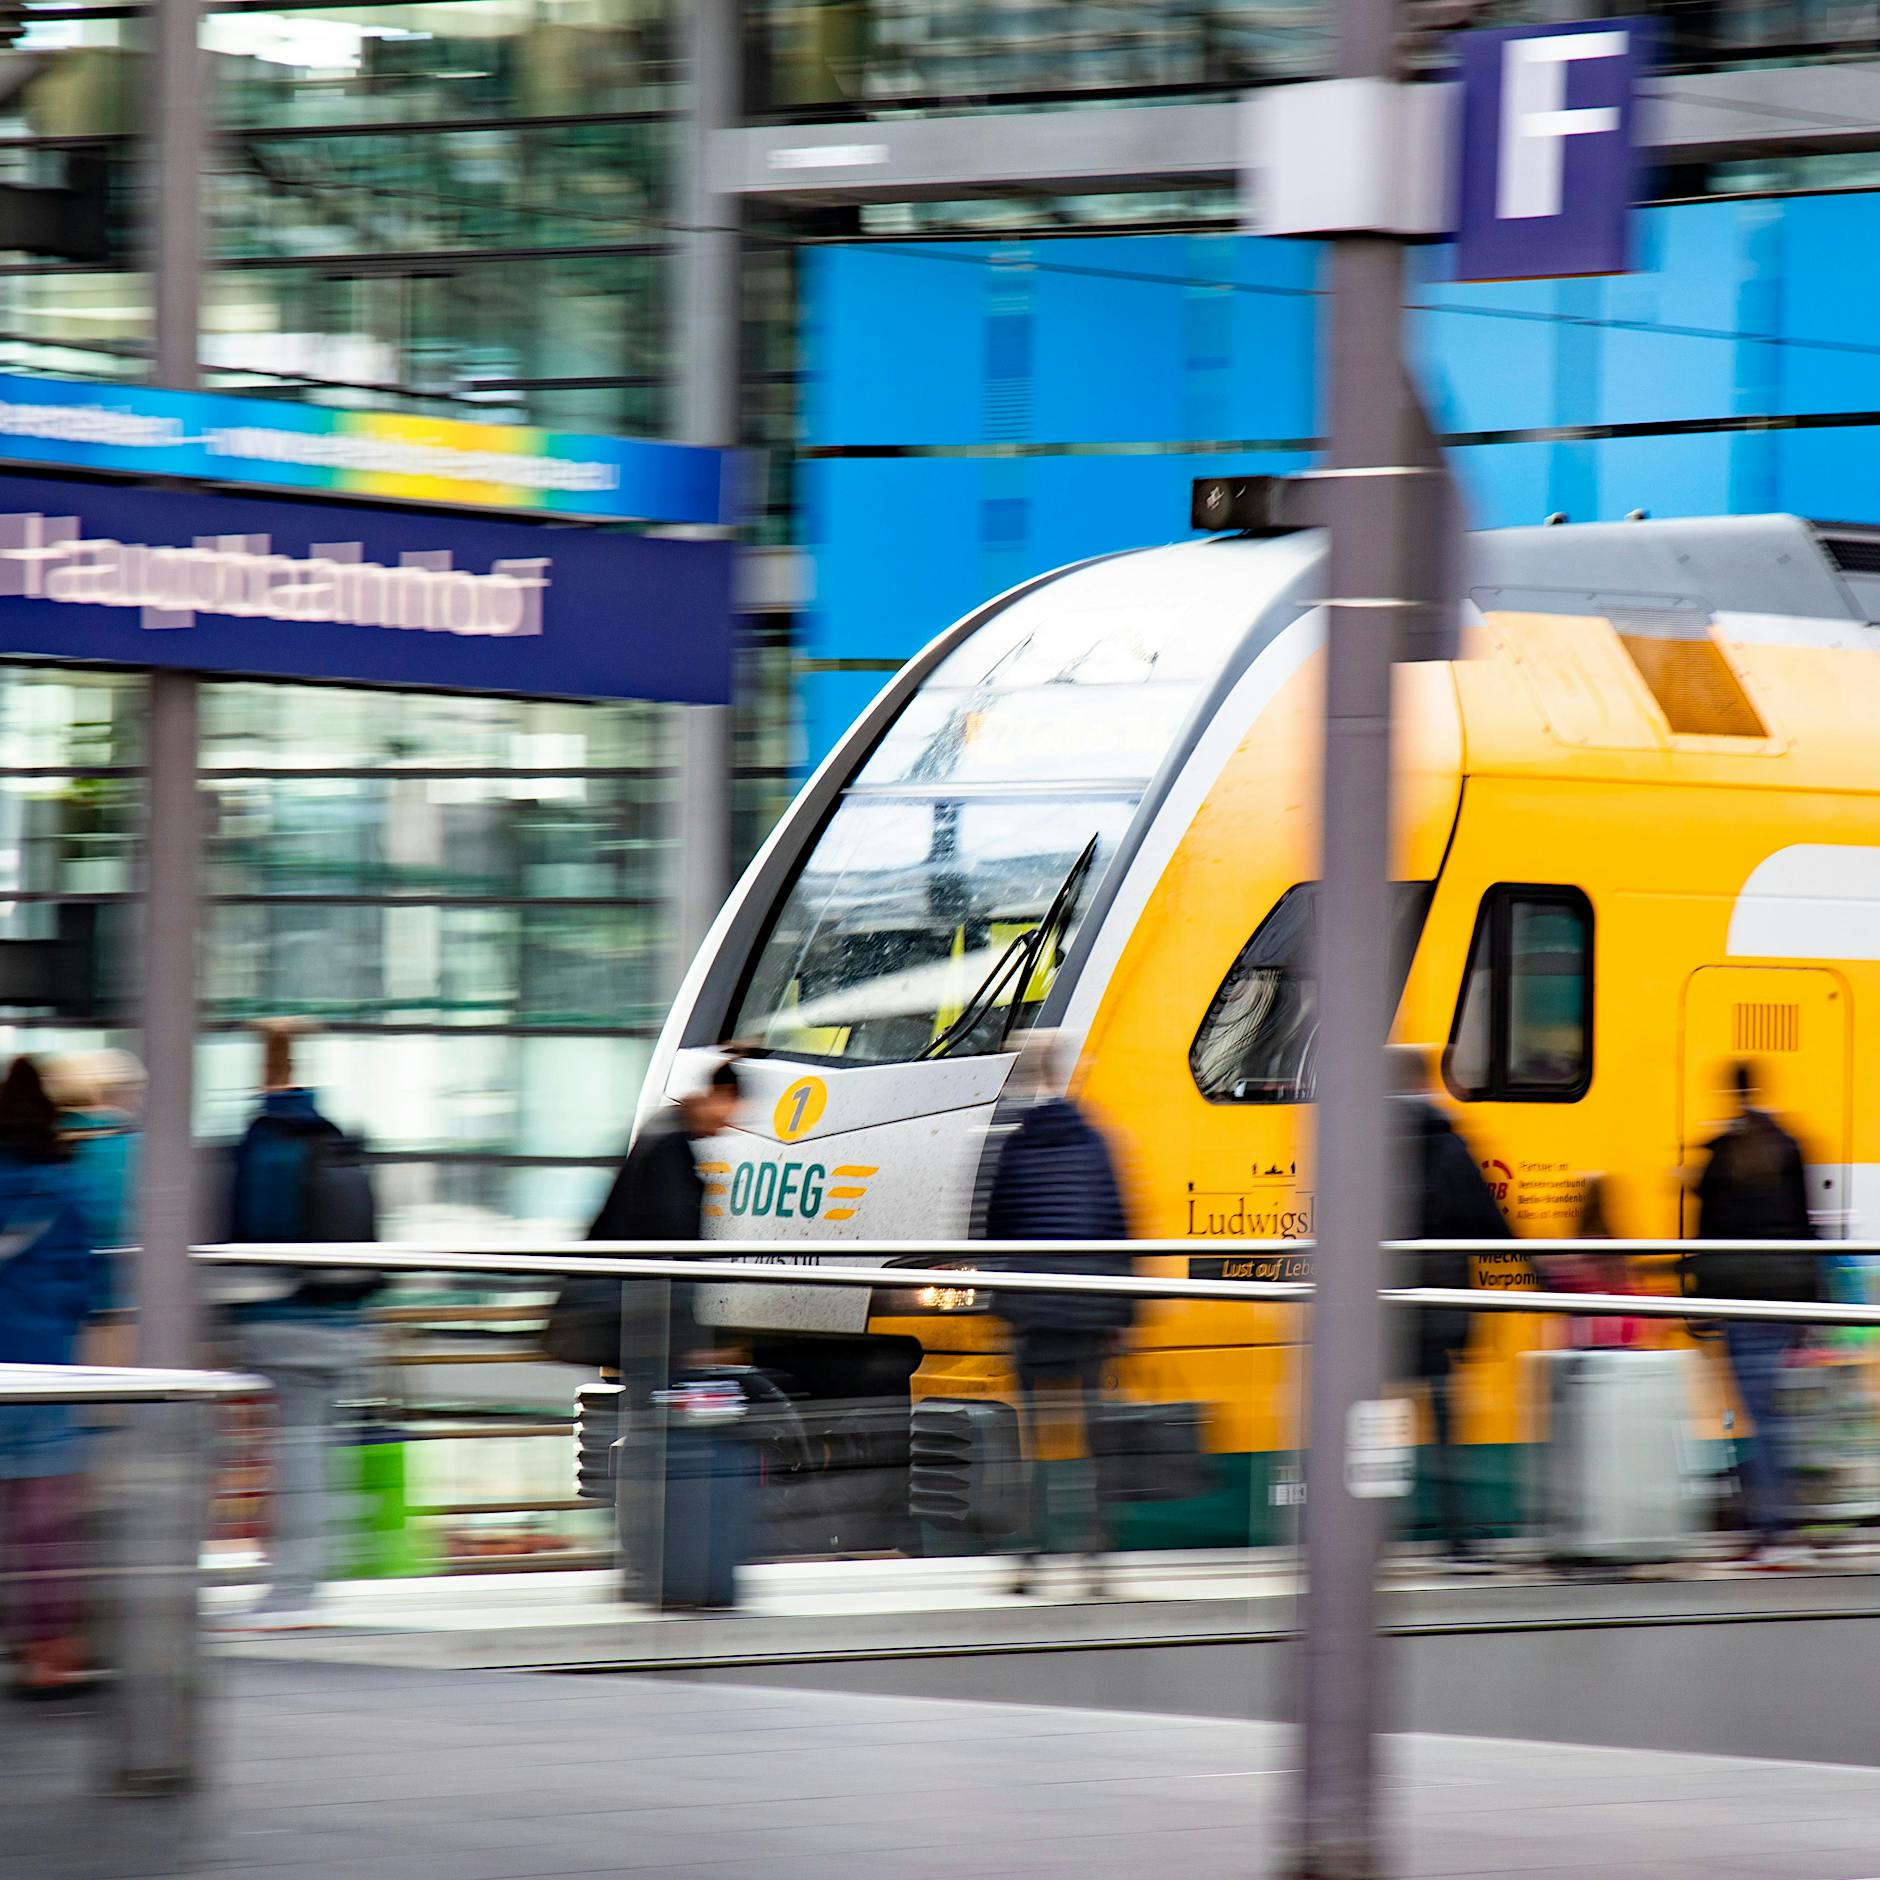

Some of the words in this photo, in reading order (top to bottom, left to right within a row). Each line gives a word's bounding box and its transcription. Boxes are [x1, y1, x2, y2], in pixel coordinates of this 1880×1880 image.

[1495, 30, 1629, 219] F
[786, 1086, 812, 1132] 1
[729, 1162, 825, 1218] ODEG
[1222, 1259, 1255, 1278] Lust
[1255, 1259, 1283, 1281] auf
